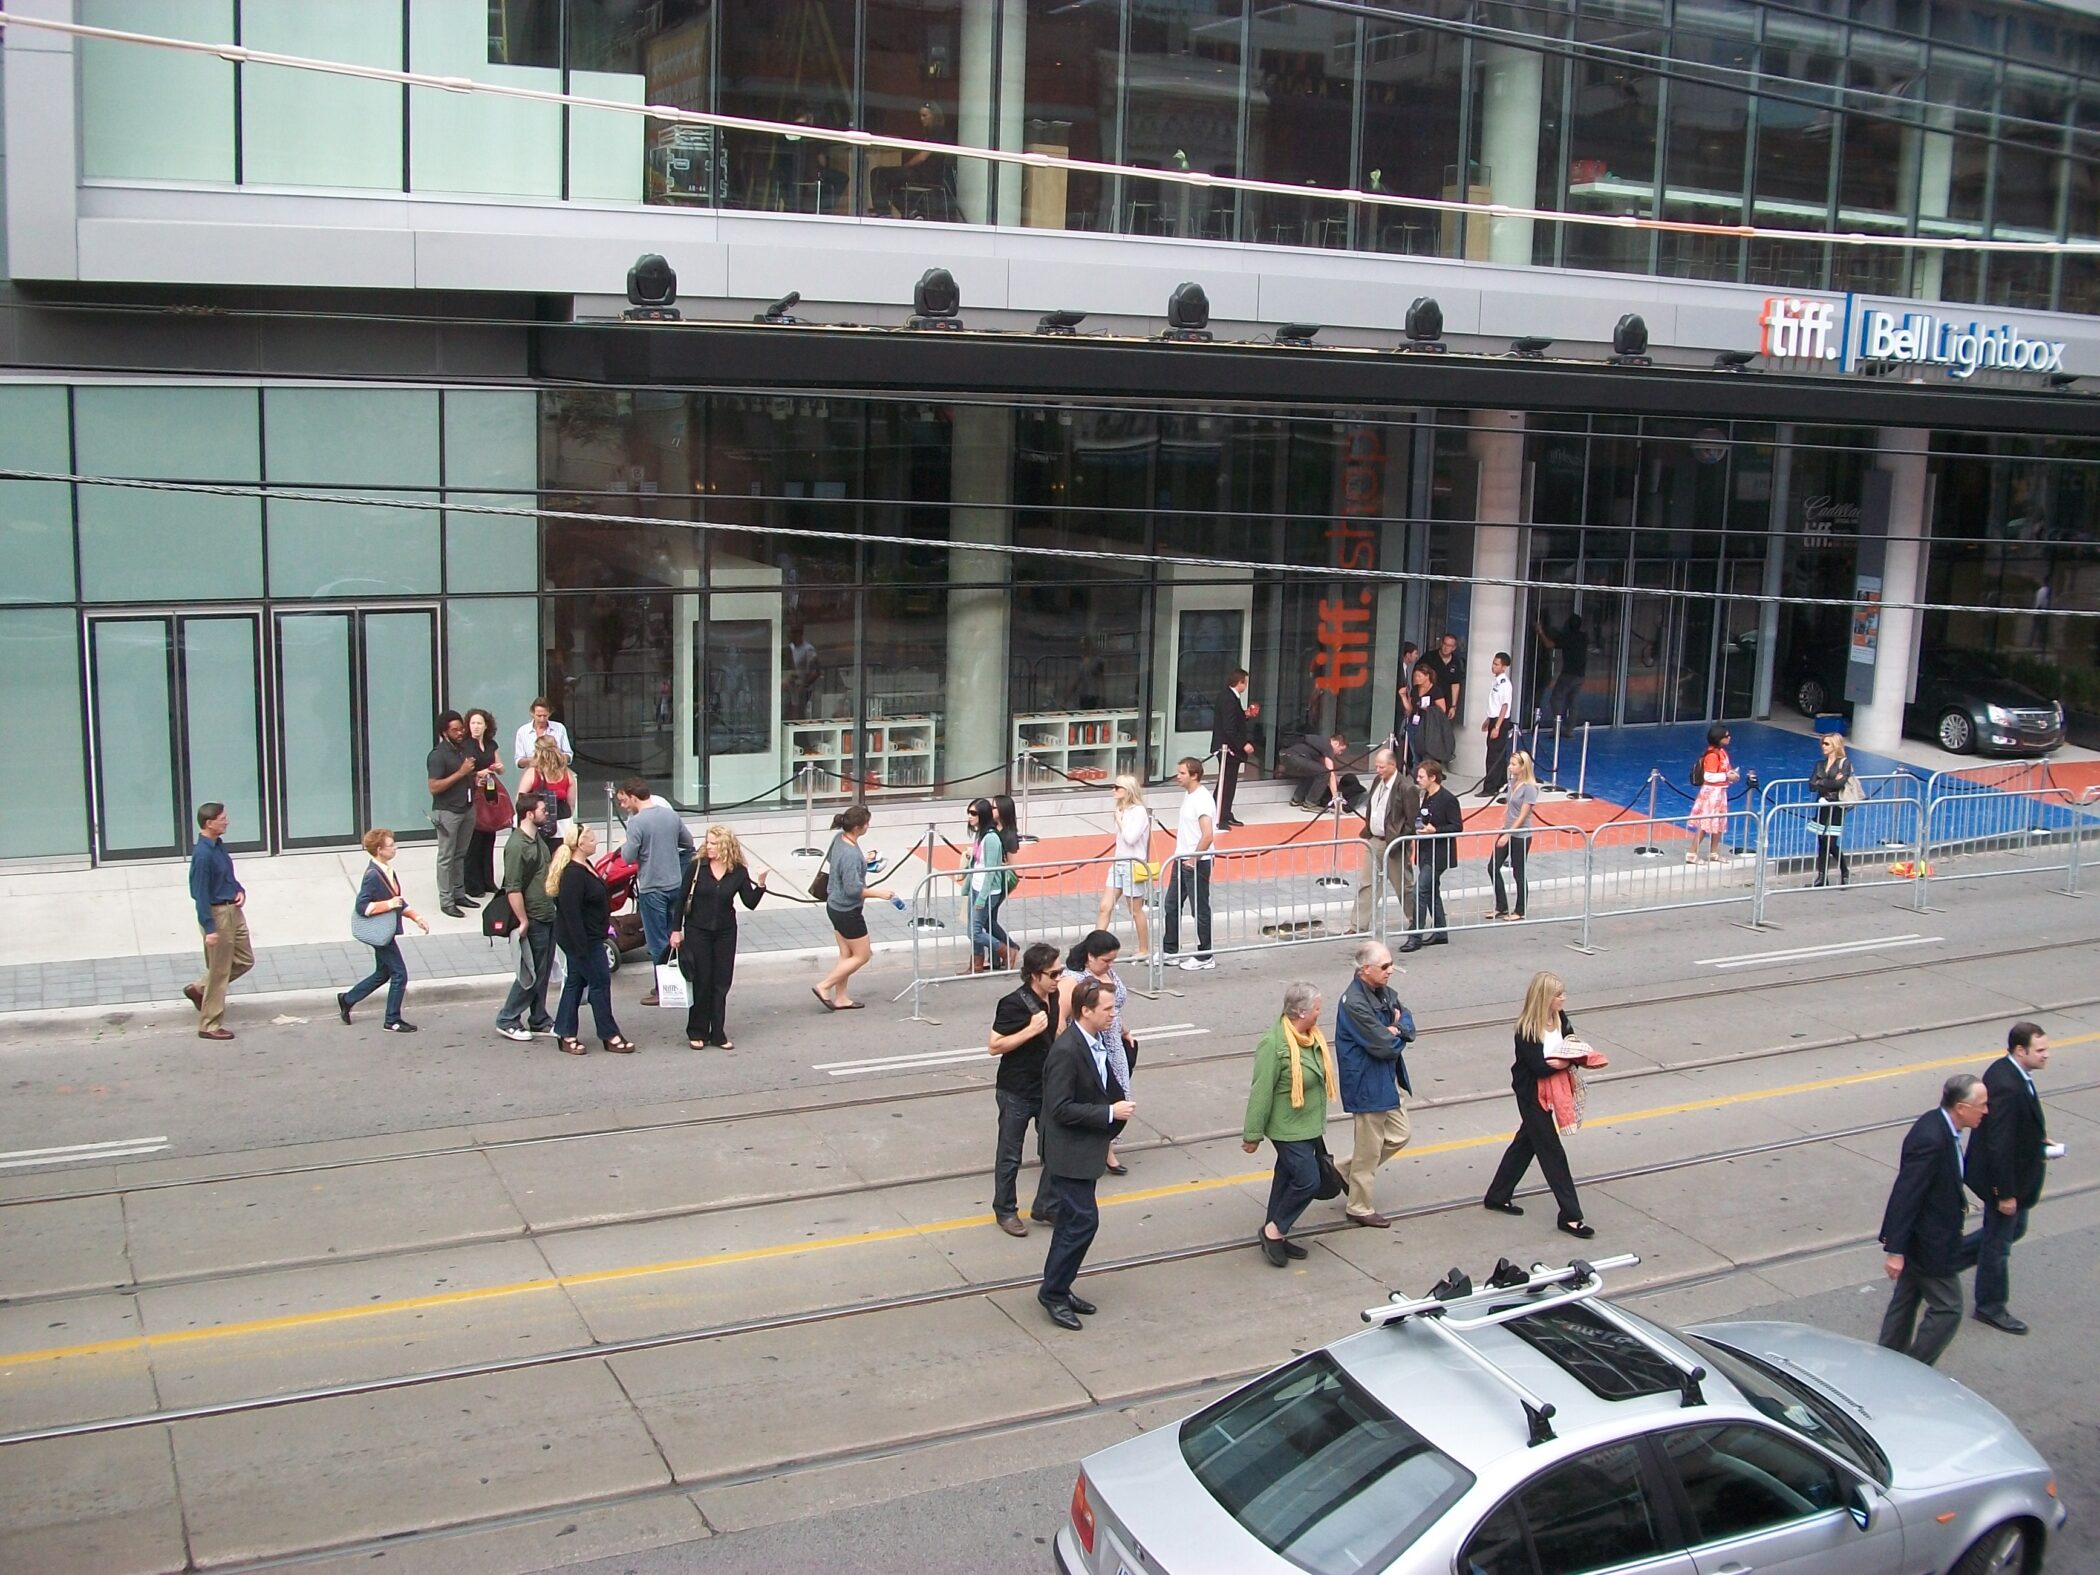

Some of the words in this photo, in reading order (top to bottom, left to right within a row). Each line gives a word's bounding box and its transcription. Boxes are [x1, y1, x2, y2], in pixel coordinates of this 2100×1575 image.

[1759, 297, 1838, 361] tiff.
[1864, 310, 1929, 361] Bell
[1934, 317, 2066, 379] Lightbox
